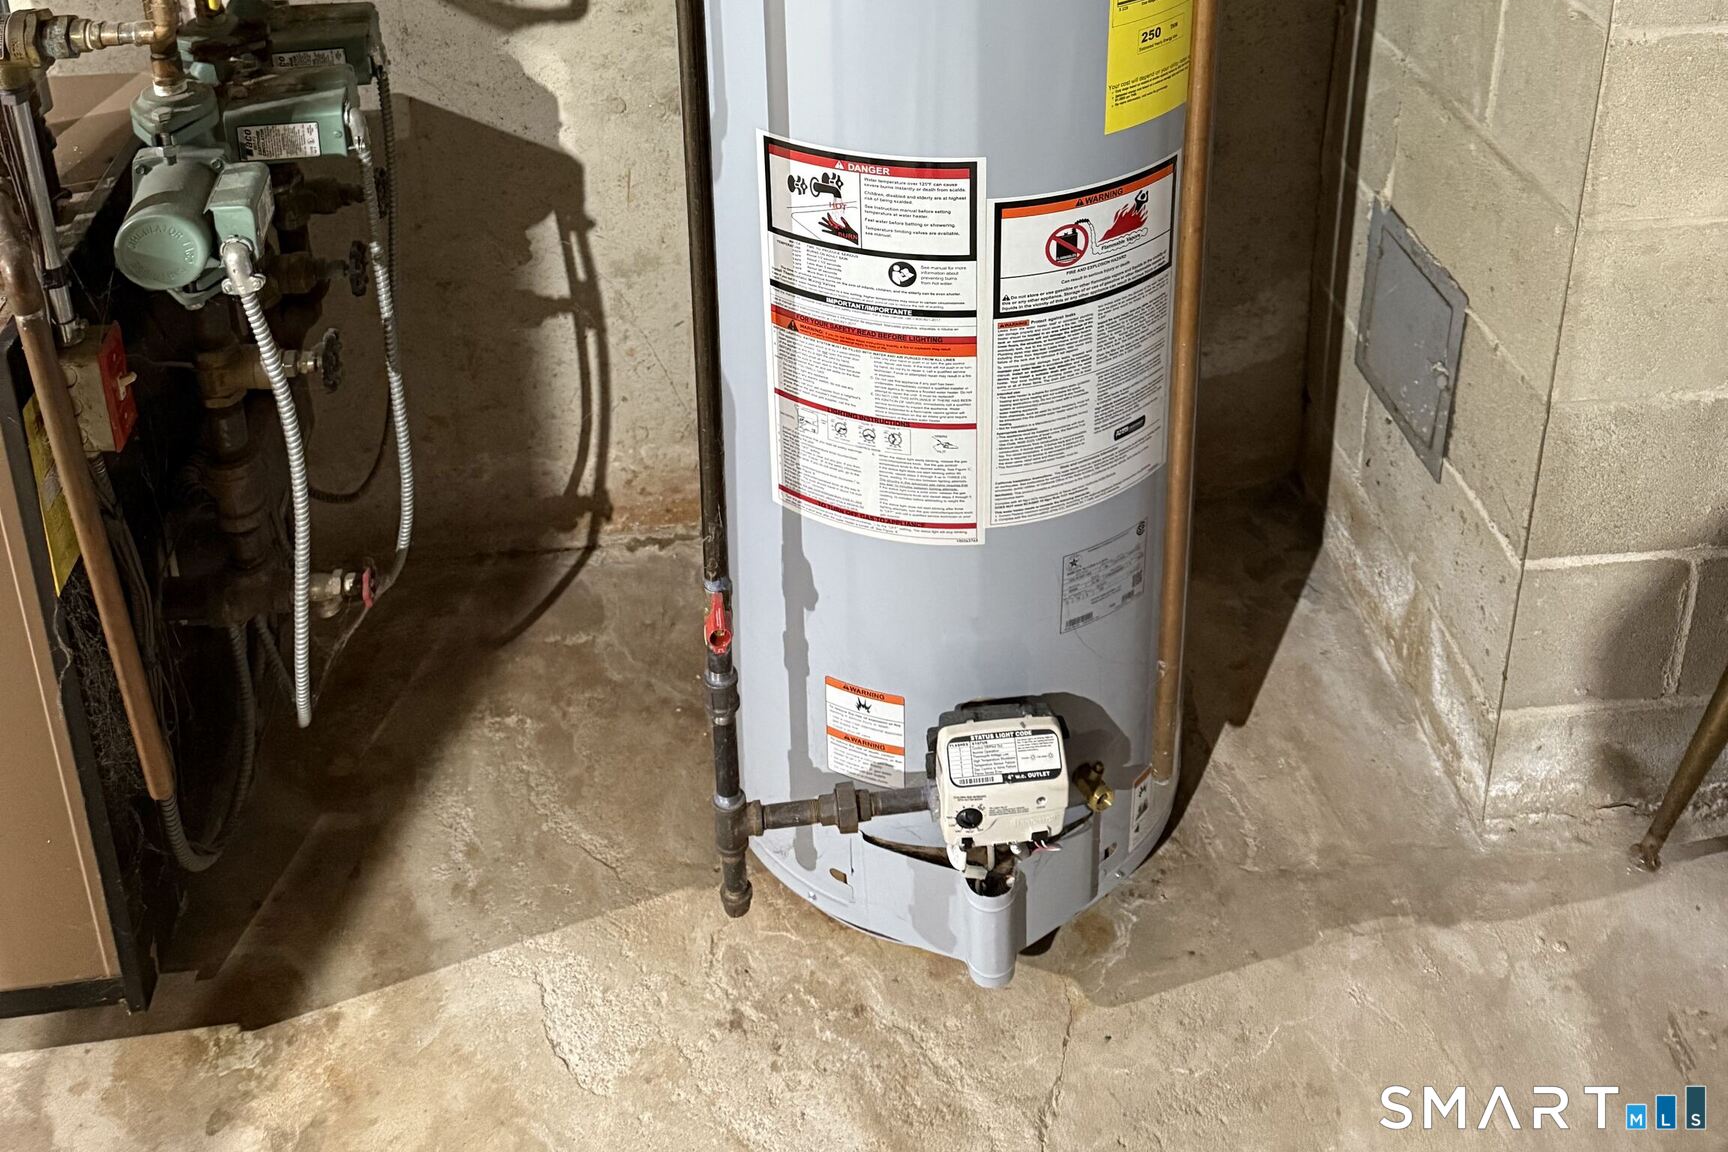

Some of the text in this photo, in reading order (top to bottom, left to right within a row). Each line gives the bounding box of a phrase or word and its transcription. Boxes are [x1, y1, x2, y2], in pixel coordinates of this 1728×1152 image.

[1141, 27, 1161, 43] 250
[848, 163, 890, 175] DANGER
[1085, 188, 1124, 206] WARNING
[1101, 240, 1125, 250] Flammable
[1087, 260, 1110, 270] EXPLOSION
[1111, 254, 1127, 263] HAZARD
[826, 297, 913, 316] IMPORTANT/IMPORTANTE
[796, 314, 809, 322] FOR
[810, 317, 828, 328] YOUR
[830, 323, 855, 333] SAFETY
[857, 328, 876, 337] READ
[849, 686, 885, 700] WARNING
[850, 737, 885, 750] WARNING
